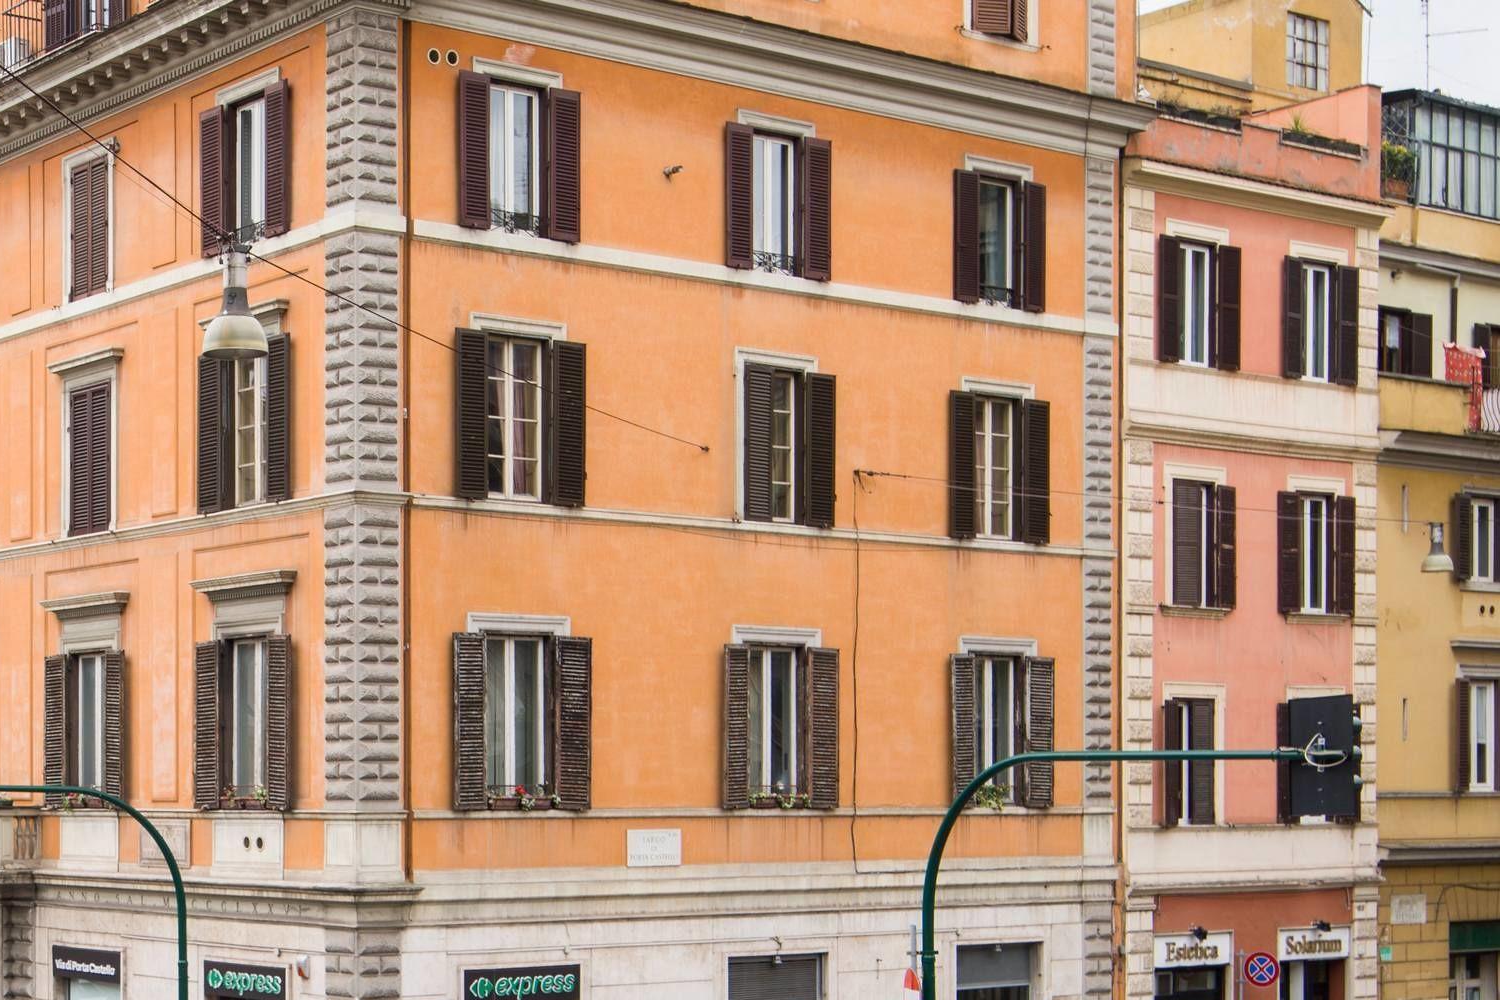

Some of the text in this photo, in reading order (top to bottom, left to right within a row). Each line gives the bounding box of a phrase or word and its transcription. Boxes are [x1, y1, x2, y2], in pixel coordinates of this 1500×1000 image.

[1165, 941, 1218, 962] Estetica
[1285, 935, 1342, 955] Solarium
[55, 958, 66, 970] Via
[72, 961, 90, 973] Porta
[90, 963, 116, 975] Castello
[223, 970, 282, 996] express
[494, 973, 576, 1000] express
